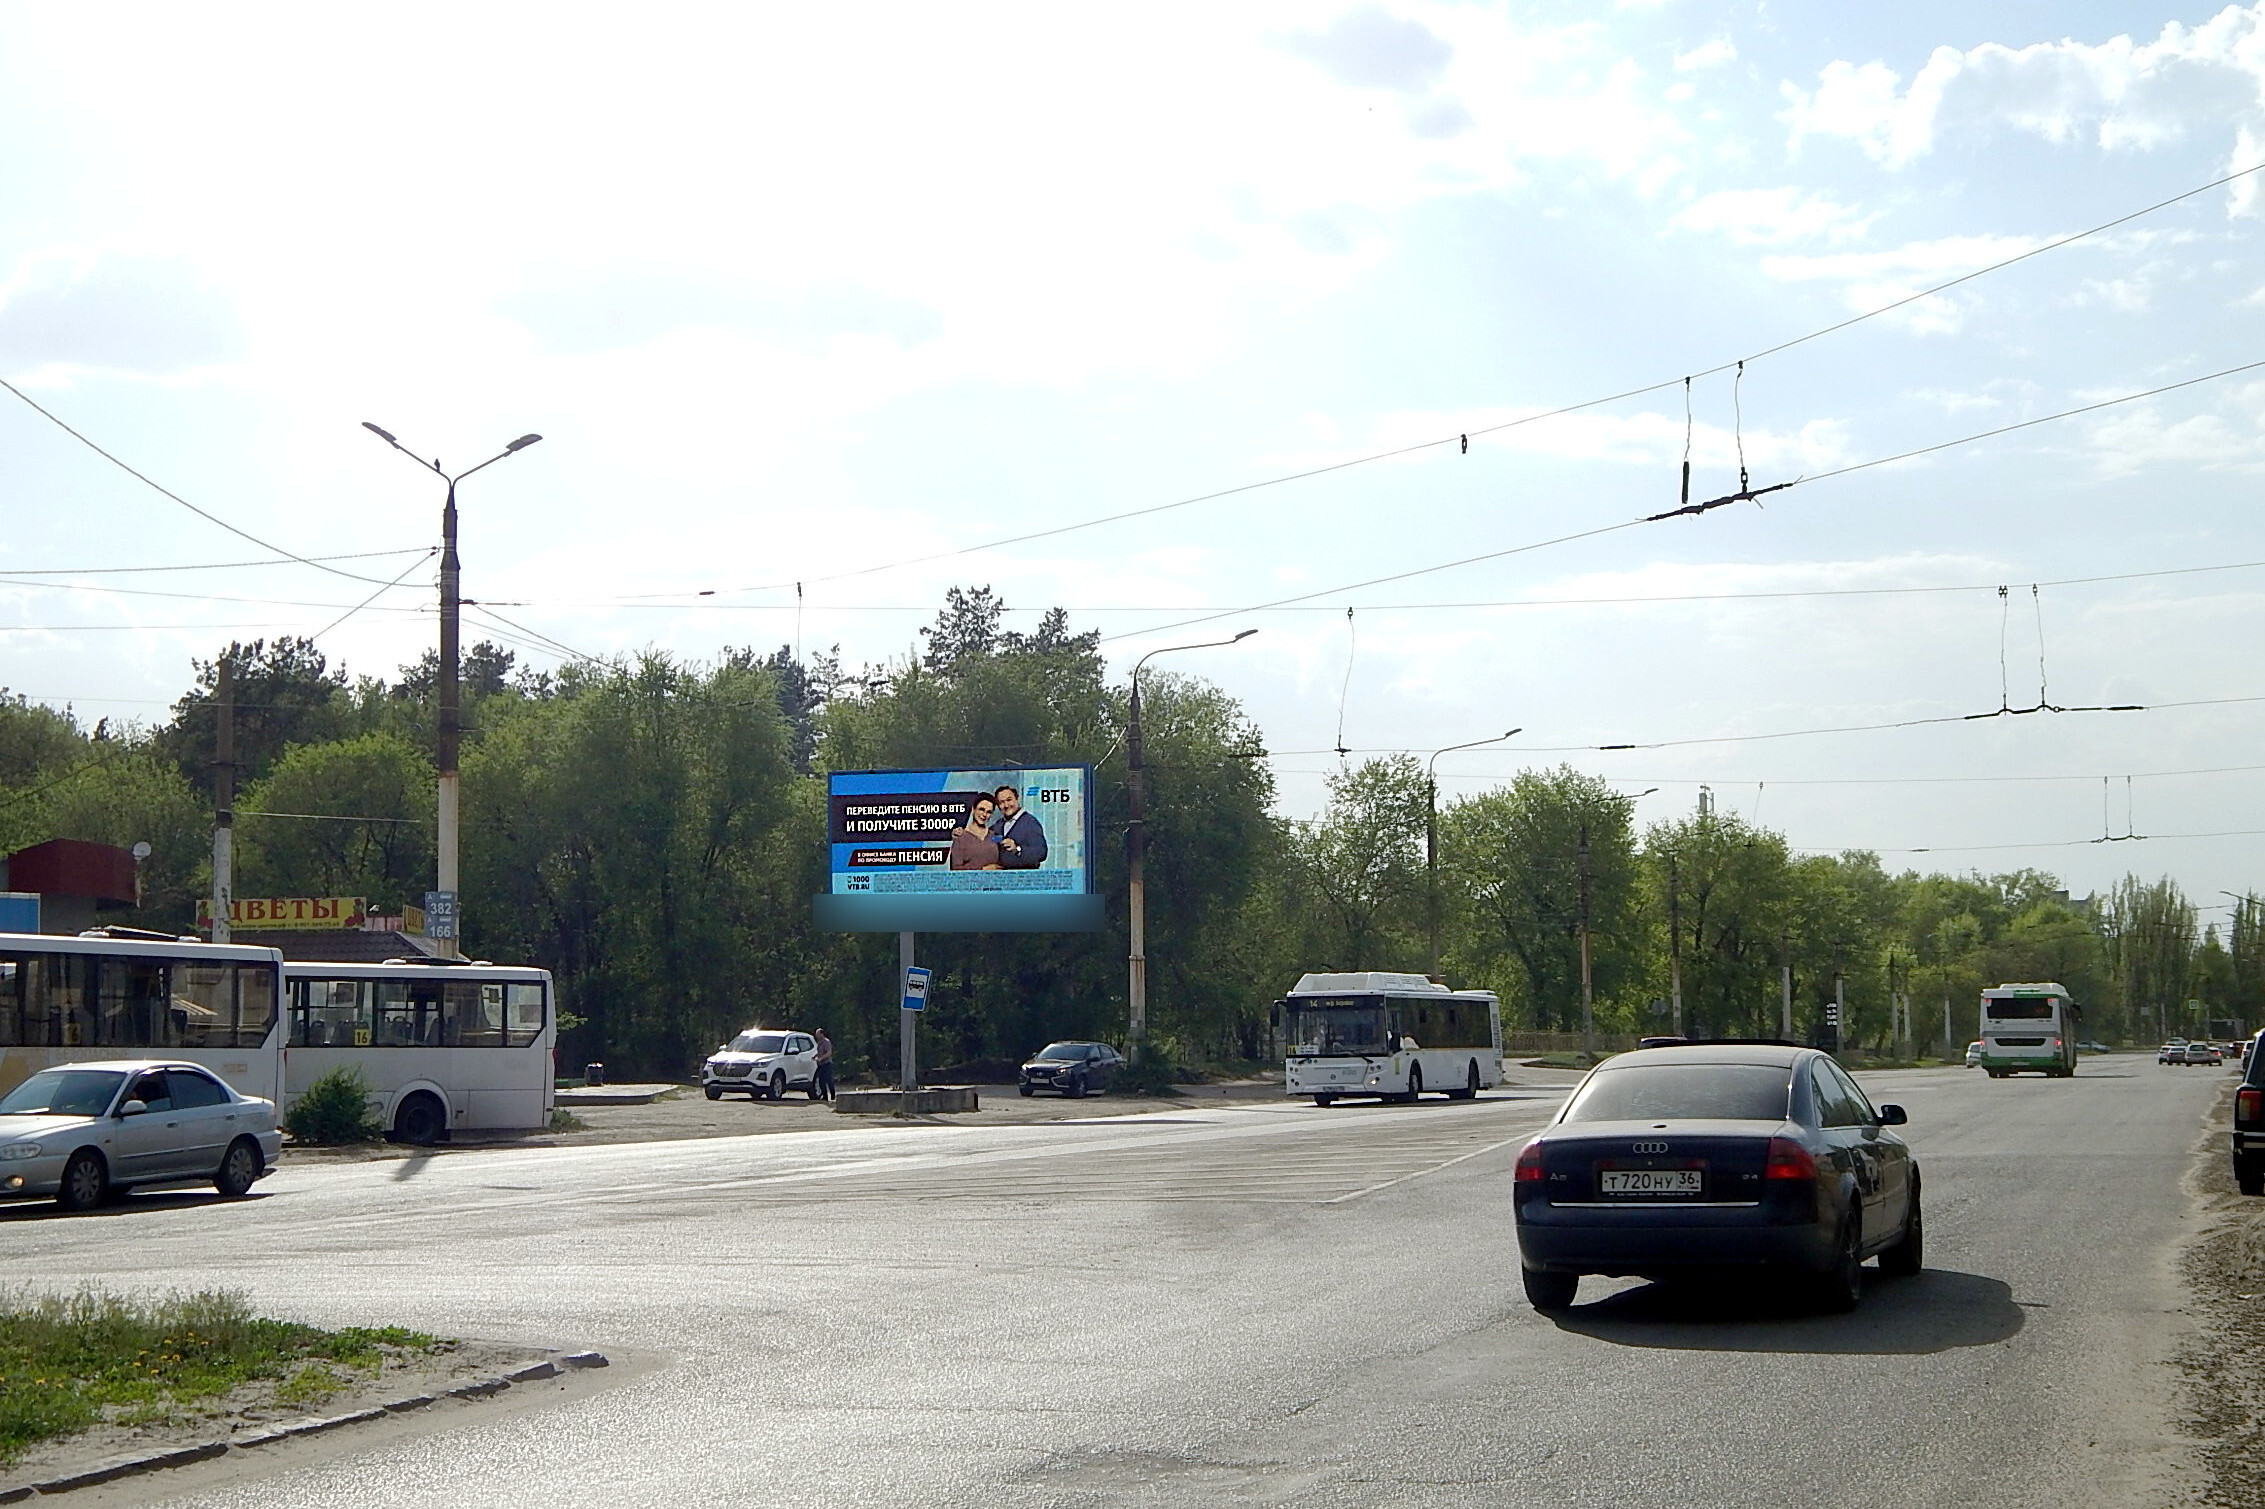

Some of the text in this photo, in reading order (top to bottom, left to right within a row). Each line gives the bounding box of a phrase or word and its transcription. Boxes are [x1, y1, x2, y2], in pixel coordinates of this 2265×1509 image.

[1041, 789, 1070, 803] ВТБ
[846, 803, 966, 817] ПЕРЕВЕДИТЕ ПЕНСИЮ В ВТБ
[846, 820, 855, 832] И
[857, 819, 919, 832] ПОЛУЧИТЕ
[898, 850, 943, 863] ПЕНСИЯ
[430, 902, 452, 915] 382
[430, 925, 451, 938] 166
[356, 1031, 368, 1044] 16
[1679, 1172, 1695, 1185] 36
